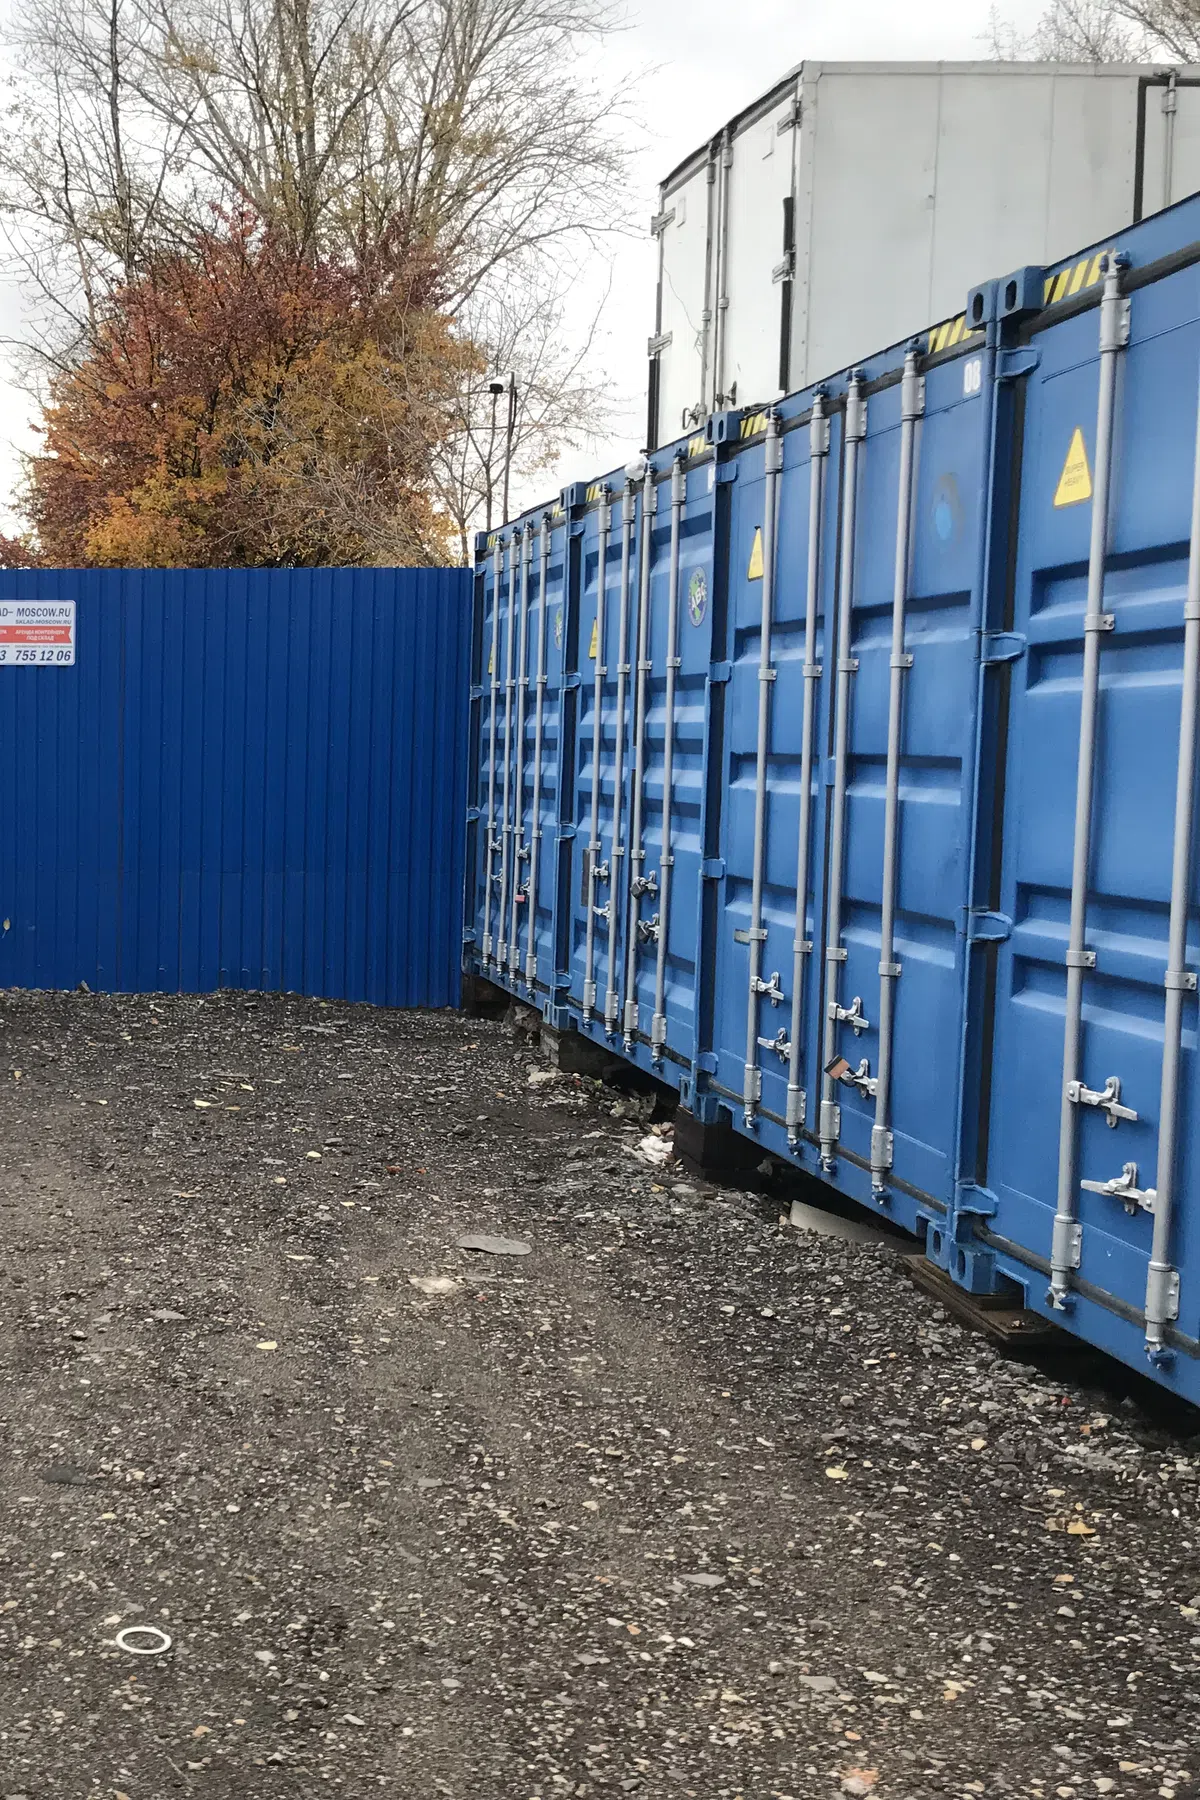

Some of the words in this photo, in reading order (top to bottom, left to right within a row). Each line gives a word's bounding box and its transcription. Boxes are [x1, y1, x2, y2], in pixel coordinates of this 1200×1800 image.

[964, 359, 981, 394] 08
[16, 607, 71, 618] MOSCOW.RU
[15, 650, 37, 661] 755
[40, 650, 54, 661] 12
[56, 650, 72, 661] 06
